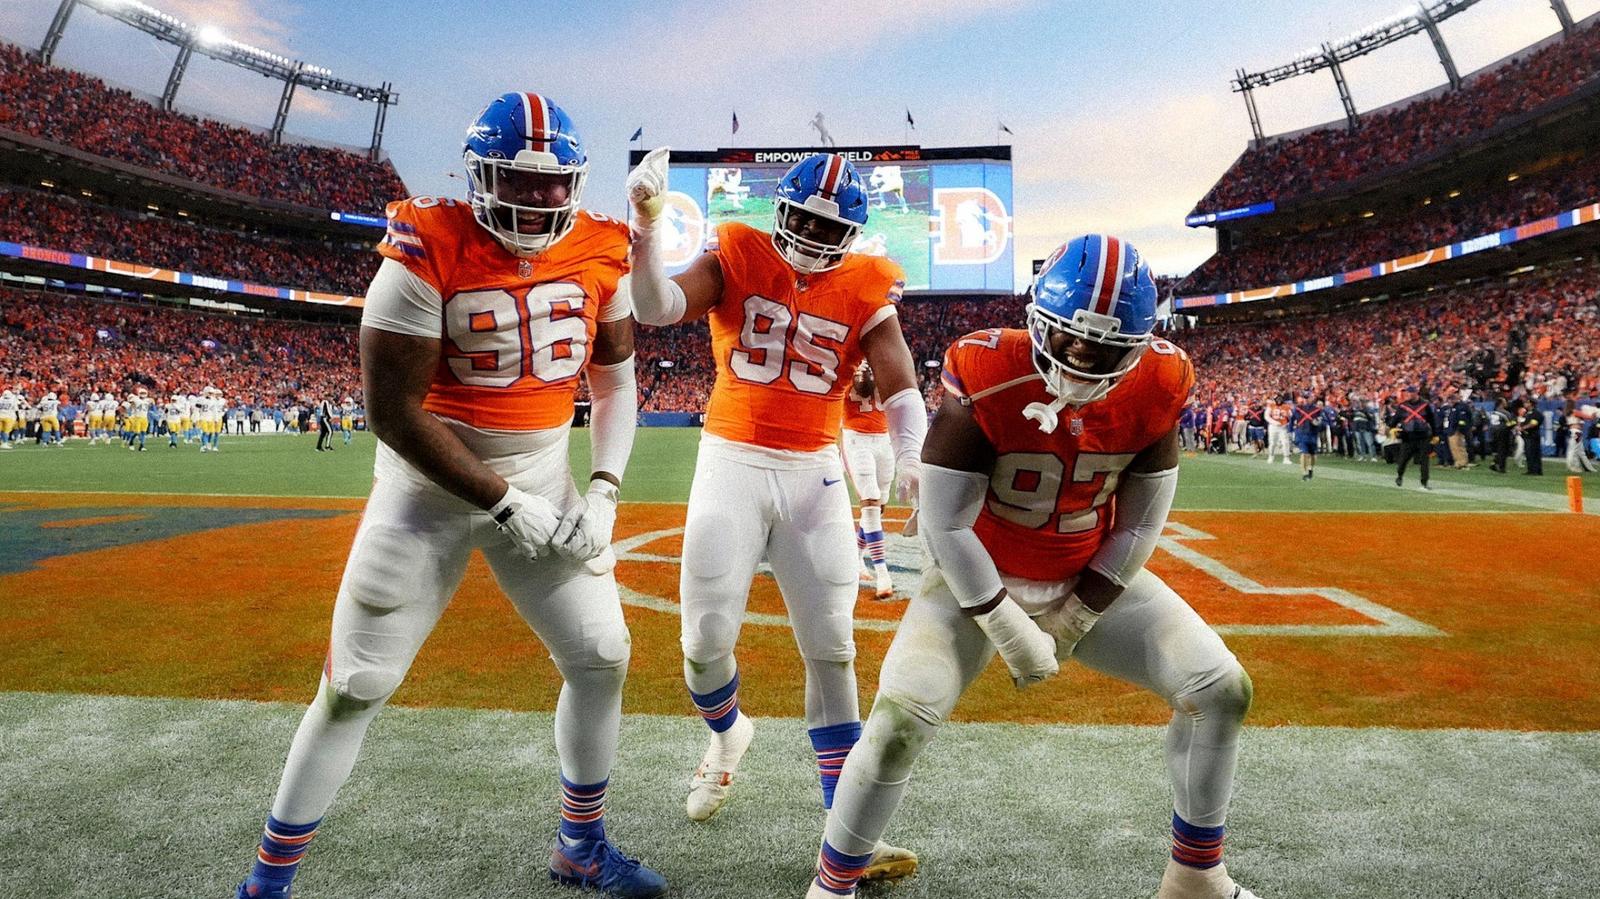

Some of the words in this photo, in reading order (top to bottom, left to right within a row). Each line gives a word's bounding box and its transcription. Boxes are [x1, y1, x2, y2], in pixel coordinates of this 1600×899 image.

[837, 152, 873, 161] FIELD
[21, 245, 72, 266] BRONCOS
[445, 281, 589, 388] 96
[728, 294, 850, 396] 95
[987, 452, 1137, 534] 97
